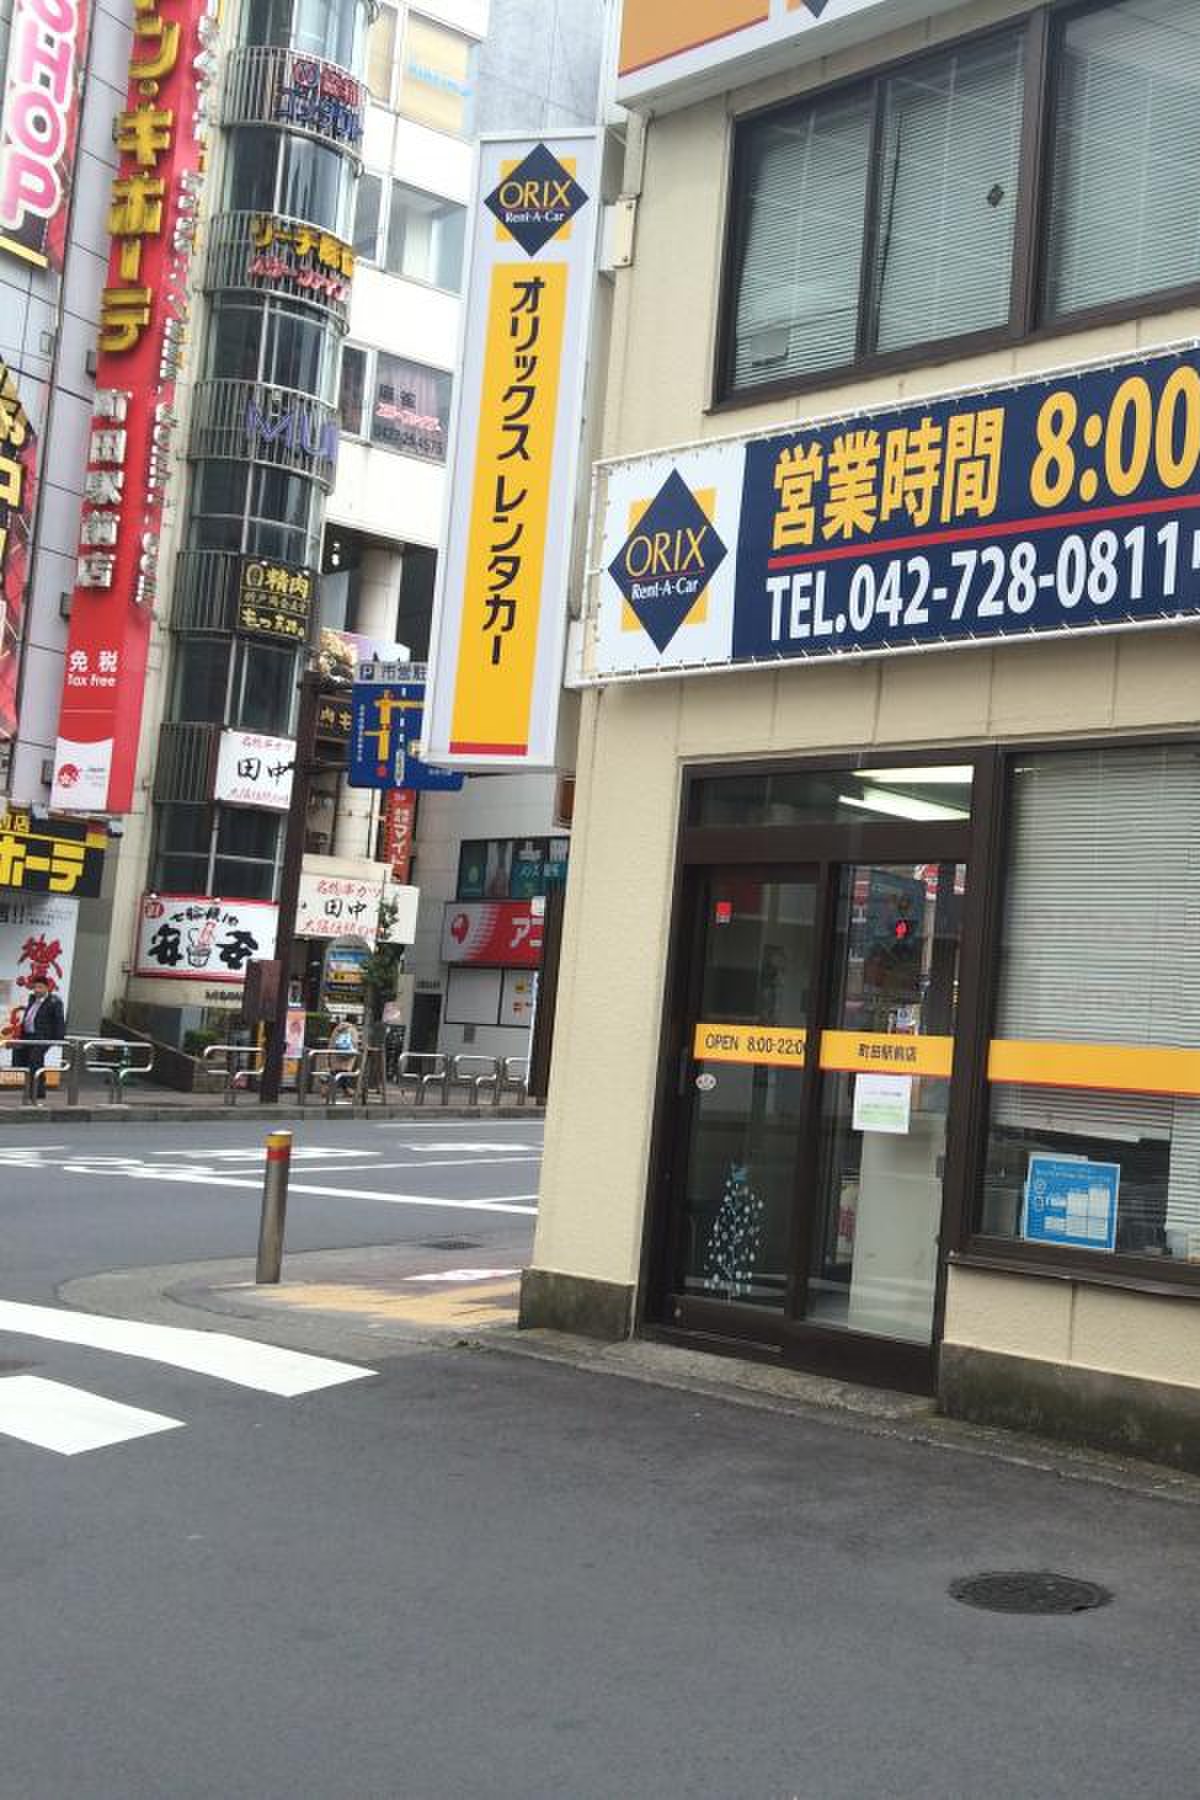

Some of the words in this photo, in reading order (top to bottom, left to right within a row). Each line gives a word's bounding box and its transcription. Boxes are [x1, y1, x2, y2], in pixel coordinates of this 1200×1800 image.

[500, 180, 572, 209] ORIX
[505, 210, 565, 223] Rent-A-Car
[772, 407, 1005, 550] 営業時間
[625, 525, 708, 577] ORIX
[631, 577, 699, 600] Rent-A-Car
[237, 757, 289, 785] 田中
[325, 898, 367, 920] 田中
[705, 1033, 739, 1051] OPEN
